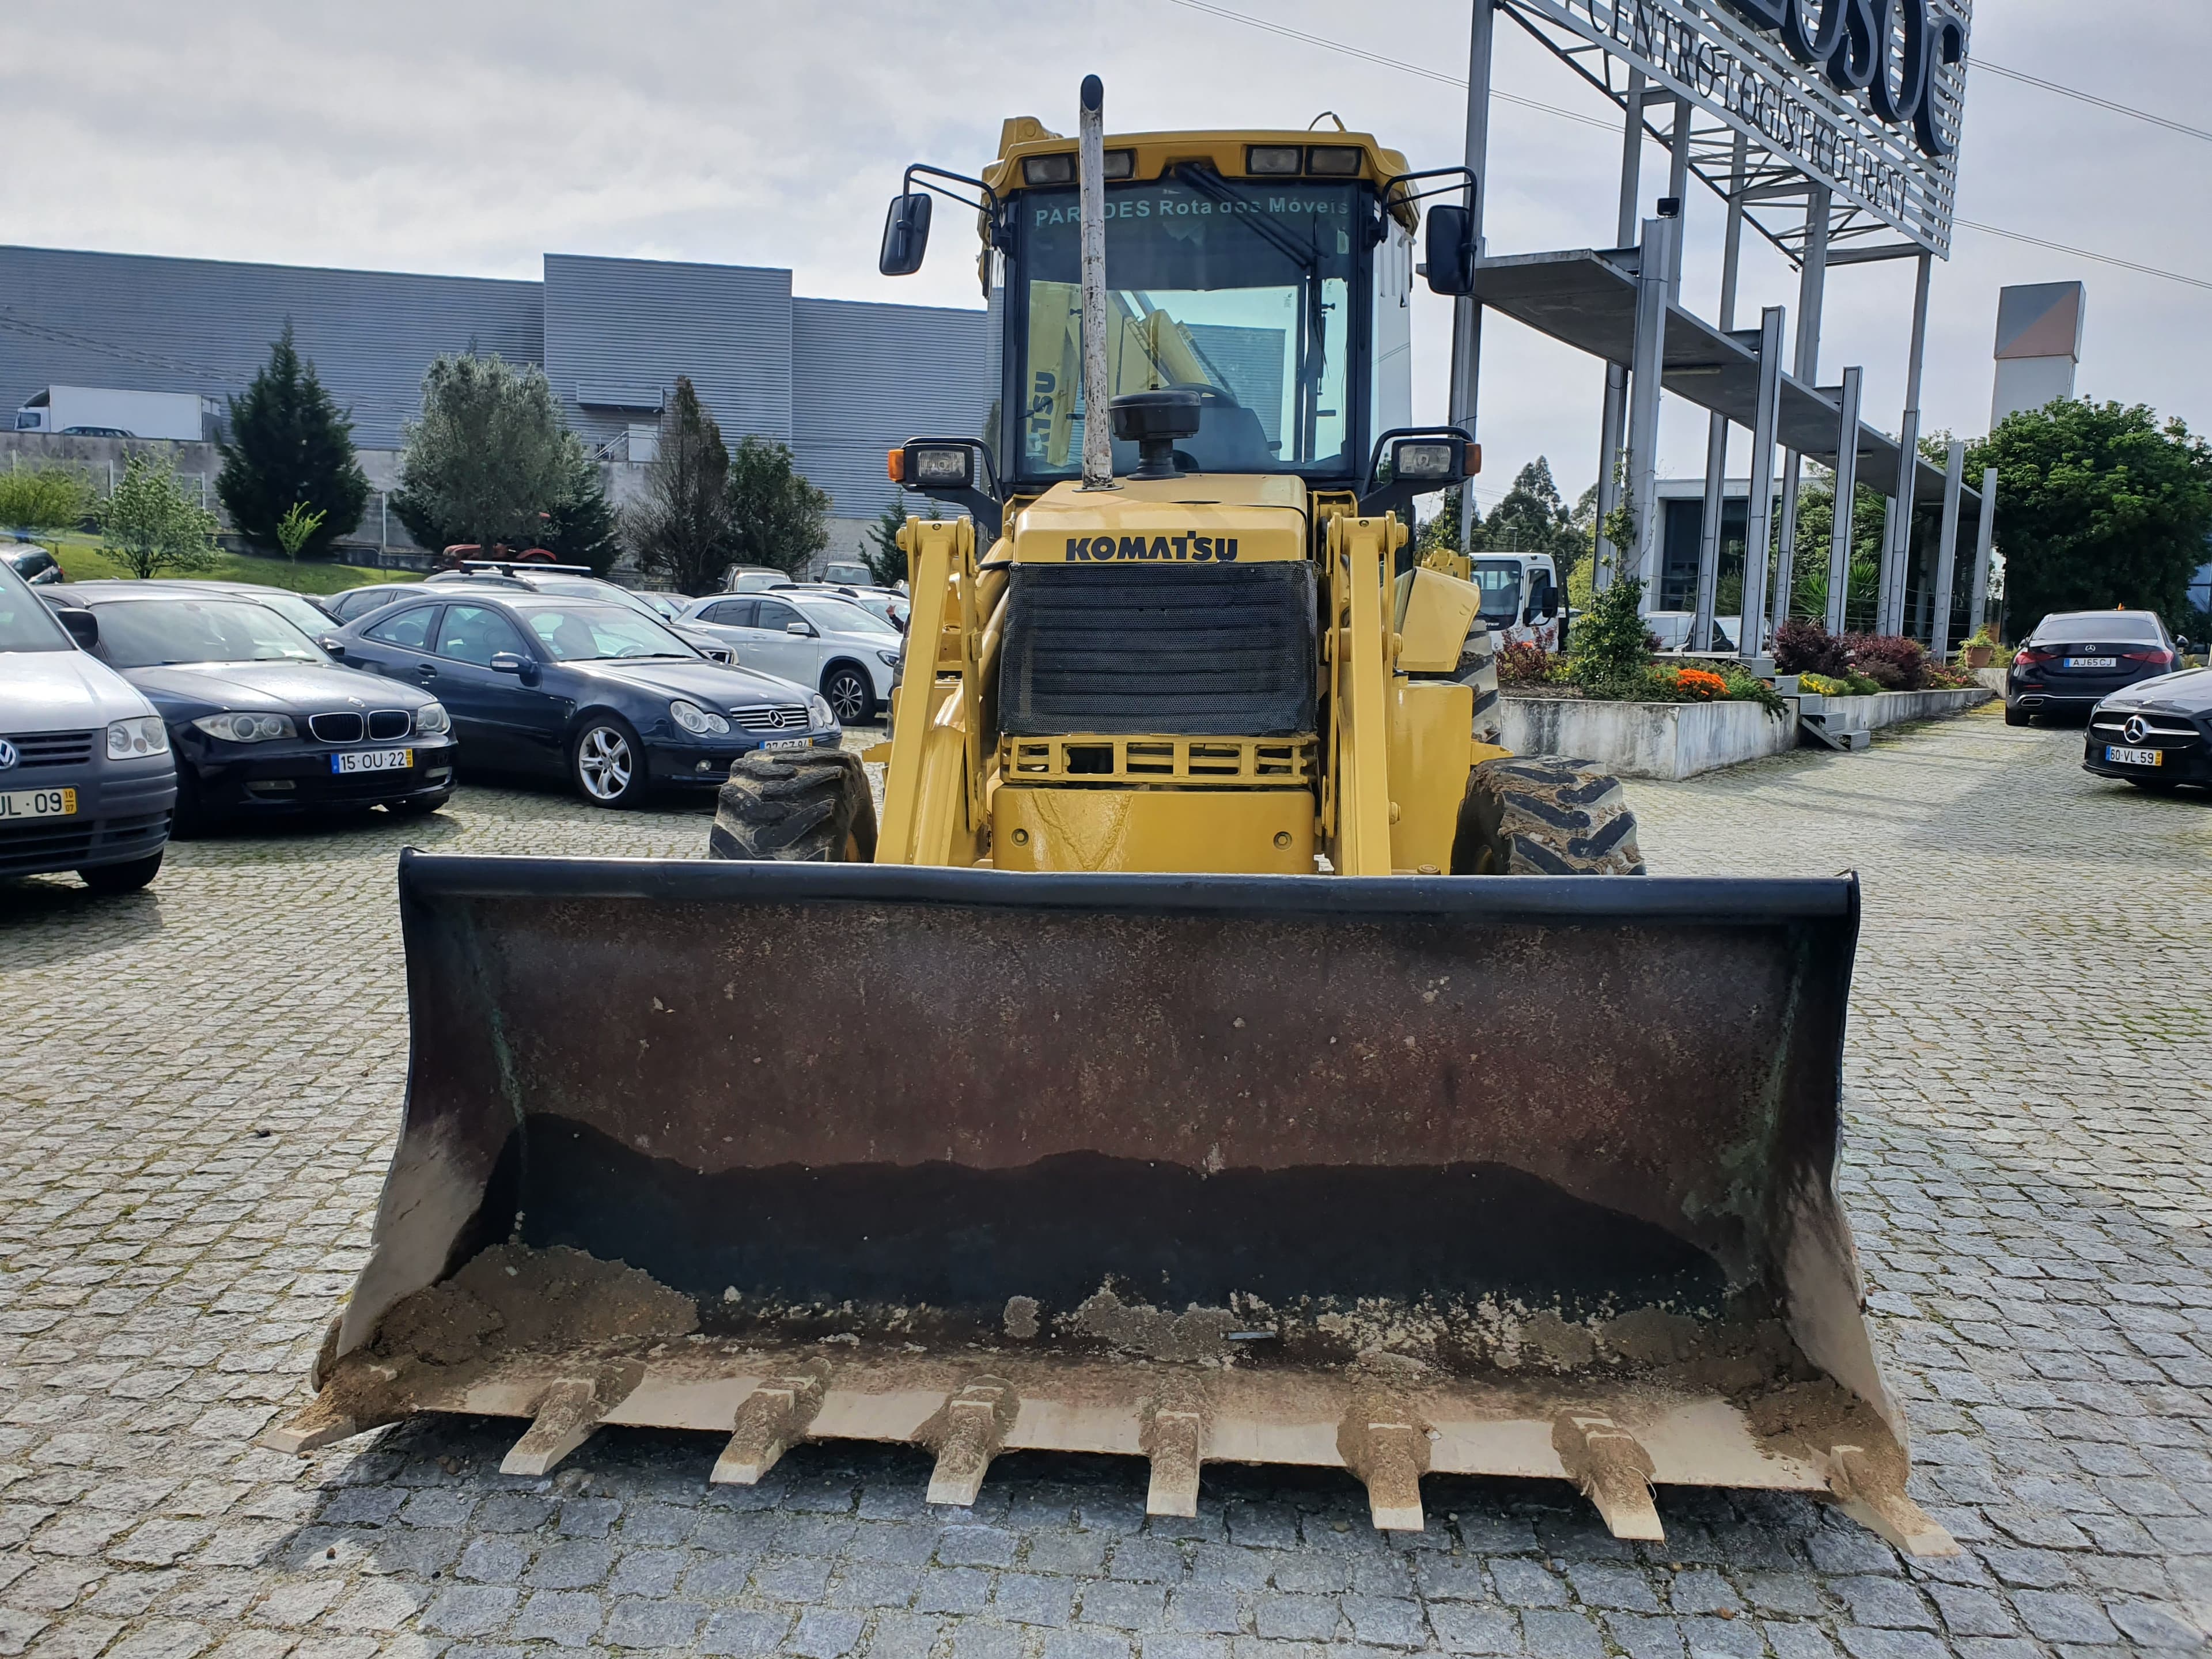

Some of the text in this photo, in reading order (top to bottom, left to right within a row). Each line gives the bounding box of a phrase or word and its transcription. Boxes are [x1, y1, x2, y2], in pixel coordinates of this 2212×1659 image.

[1588, 0, 1716, 99] CENTRO
[1860, 150, 1911, 221] RENT
[1722, 0, 1963, 157] SOC
[1036, 200, 1150, 226] PARDES
[1159, 199, 1212, 215] Rota
[1269, 196, 1349, 215] Móveis
[1066, 531, 1238, 561] KOMATSU
